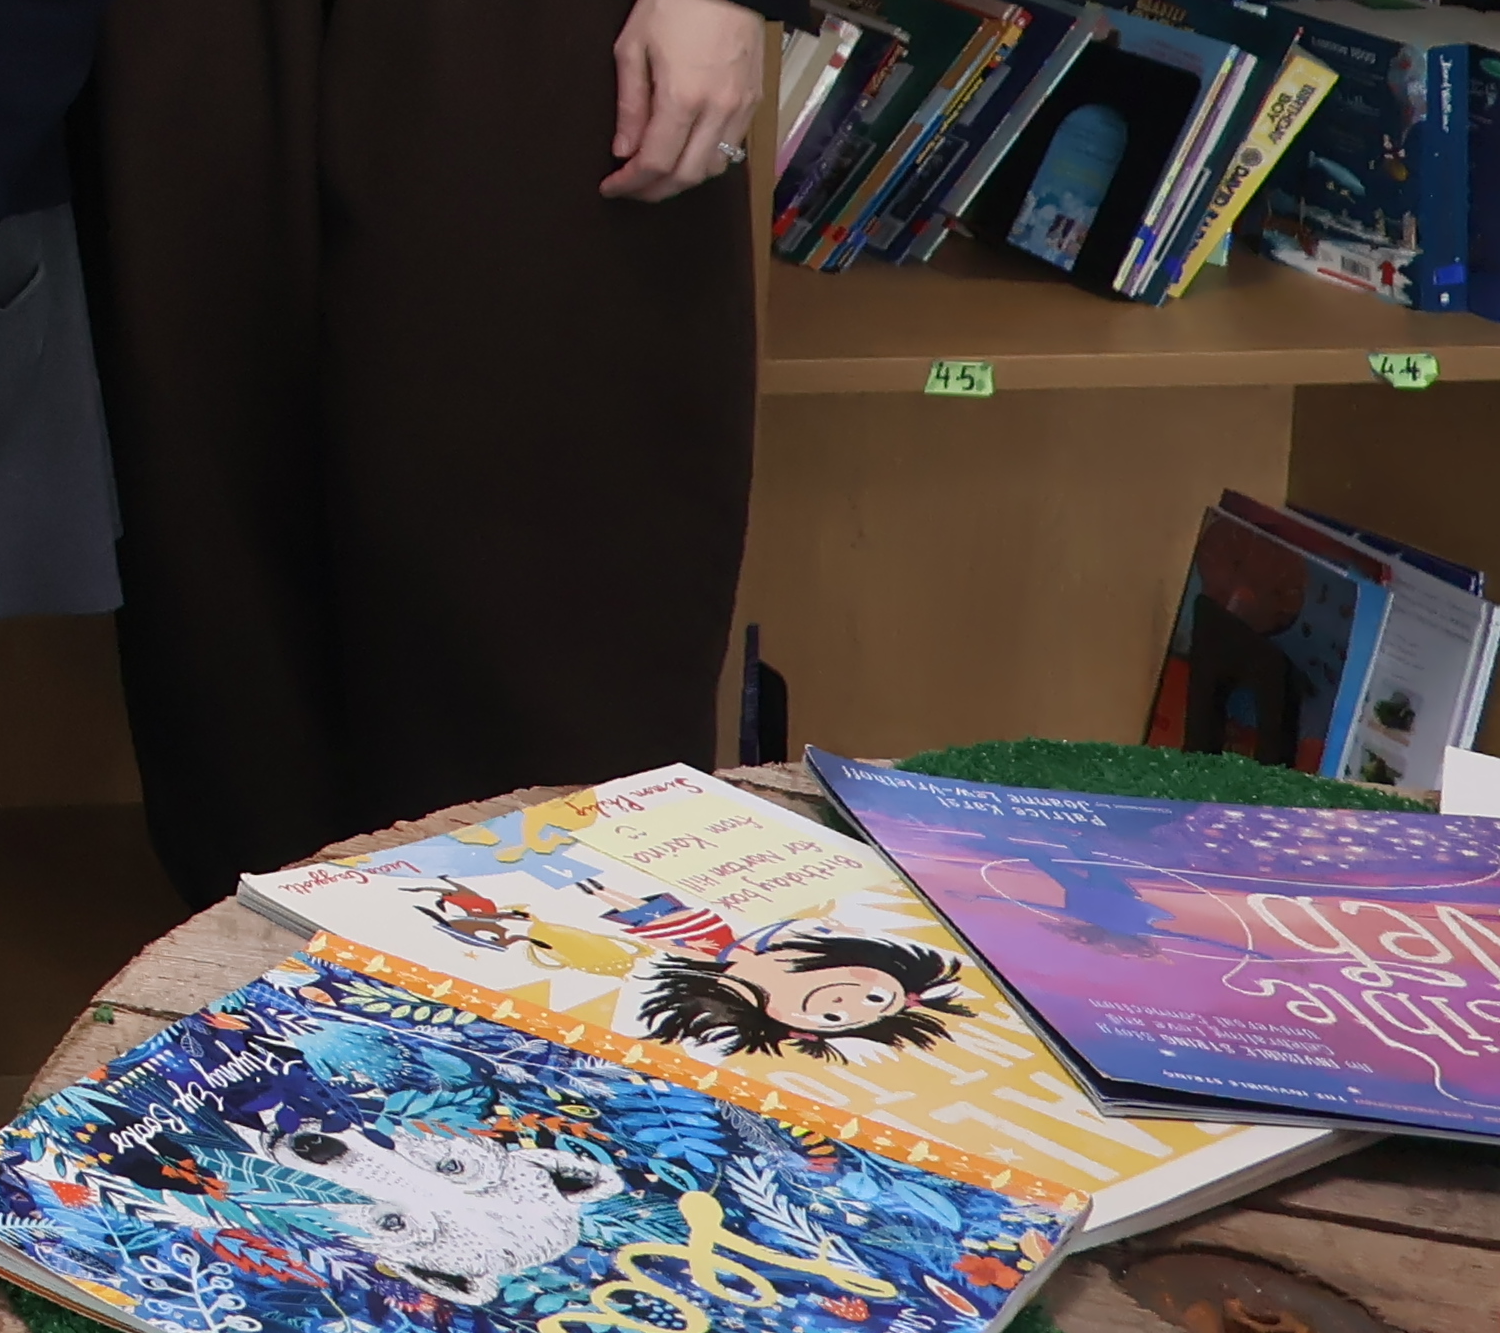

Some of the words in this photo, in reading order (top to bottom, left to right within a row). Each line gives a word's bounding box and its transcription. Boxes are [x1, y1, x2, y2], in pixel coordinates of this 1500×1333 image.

[629, 777, 704, 801] Simon
[936, 795, 1004, 817] Karst
[1006, 793, 1091, 814] Joanne
[703, 815, 764, 834] from
[1011, 805, 1107, 827] Patrice
[622, 834, 719, 866] Karina
[782, 839, 823, 857] for
[708, 848, 781, 874] Norton
[675, 868, 712, 891] Hill
[757, 854, 863, 895] Birthday
[710, 884, 772, 914] book
[1158, 1033, 1229, 1055] STRING
[203, 1039, 303, 1090] Flying
[1229, 1041, 1340, 1072] INVISIBLE
[172, 1058, 224, 1111] Eye
[1161, 1068, 1224, 1086] STRING
[1227, 1079, 1309, 1099] INVISIBLE
[1316, 1091, 1348, 1104] THE
[108, 1102, 184, 1154] Books
